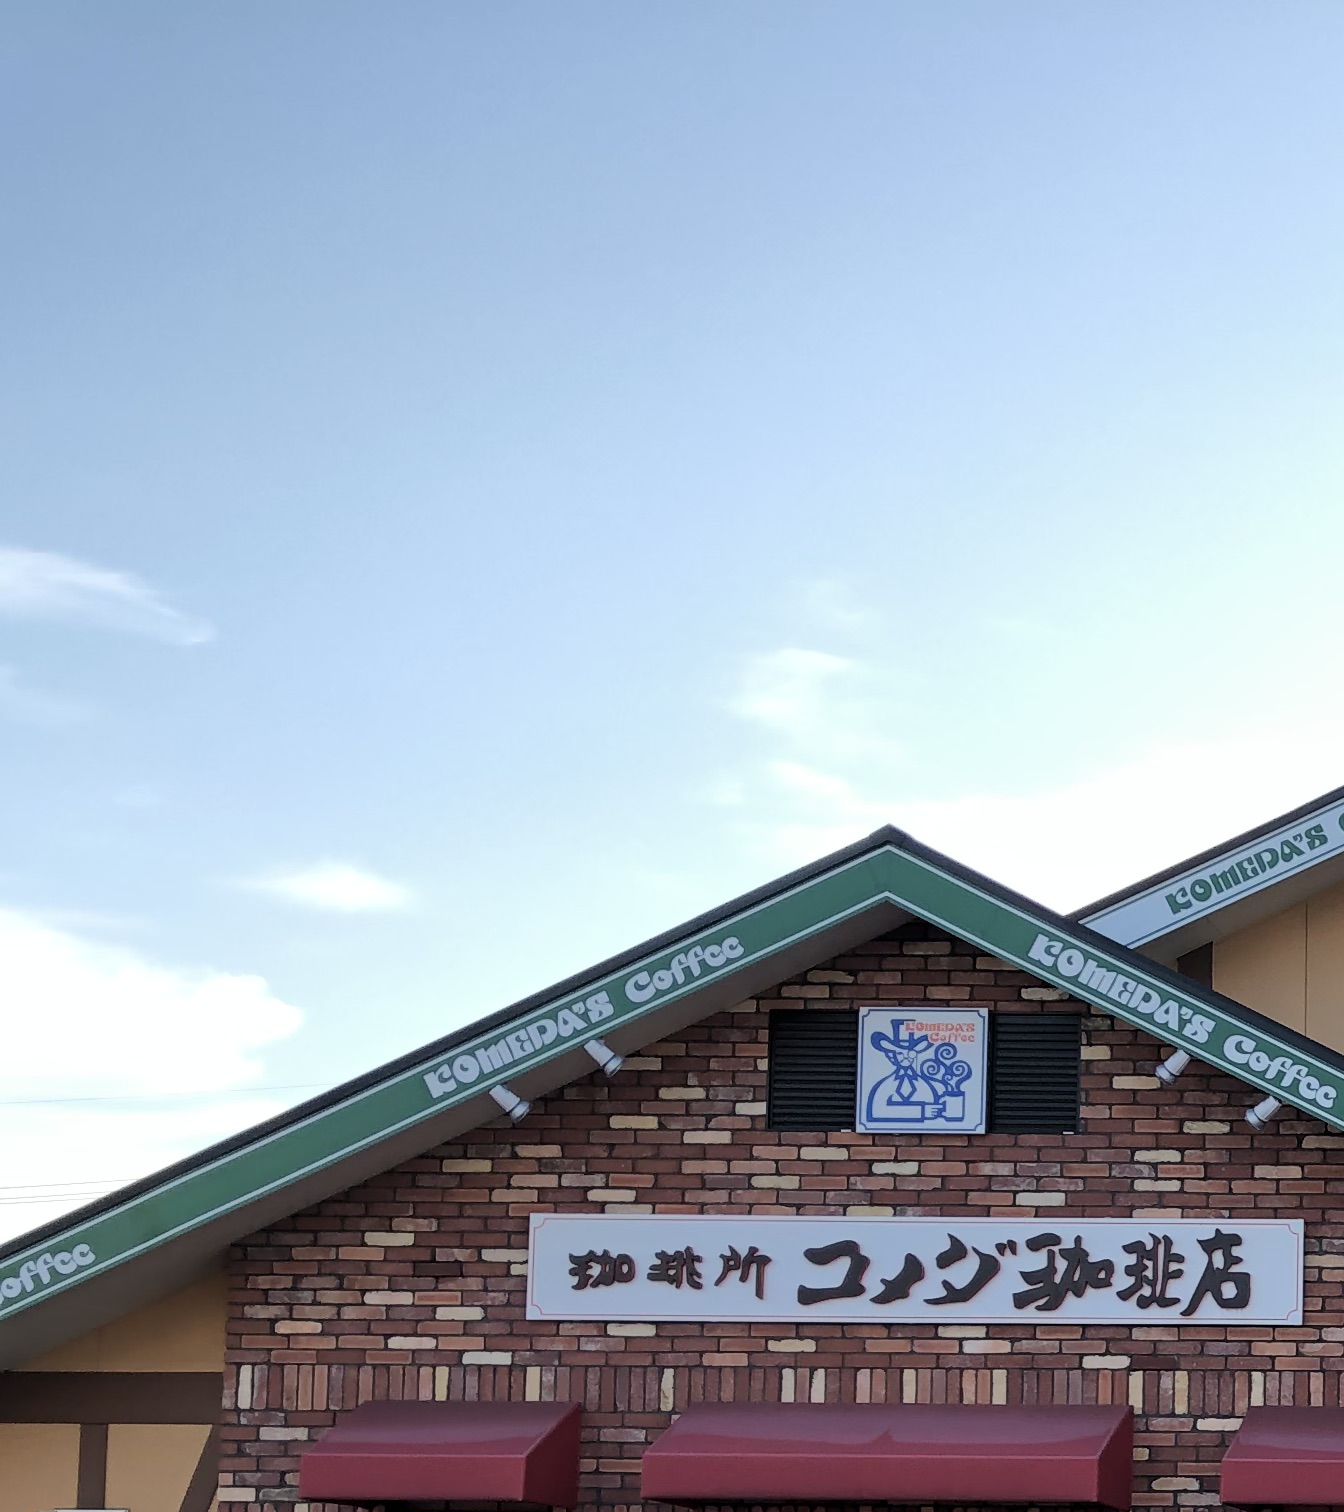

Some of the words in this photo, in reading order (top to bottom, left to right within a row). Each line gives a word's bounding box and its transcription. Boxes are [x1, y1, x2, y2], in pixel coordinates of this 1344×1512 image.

[1166, 824, 1328, 914] KOMEDA'S
[423, 990, 615, 1099] KOMEDA'S
[624, 935, 744, 1002] Coffee
[905, 1022, 975, 1032] KOMEDA'S
[929, 1032, 975, 1043] Coffee
[1028, 934, 1217, 1045] KOMEDA'S
[1224, 1034, 1336, 1109] Coffee
[0, 1243, 96, 1305] offee
[568, 1244, 768, 1300] 珈琲所
[797, 1228, 1251, 1317] コメダ珈琲店
